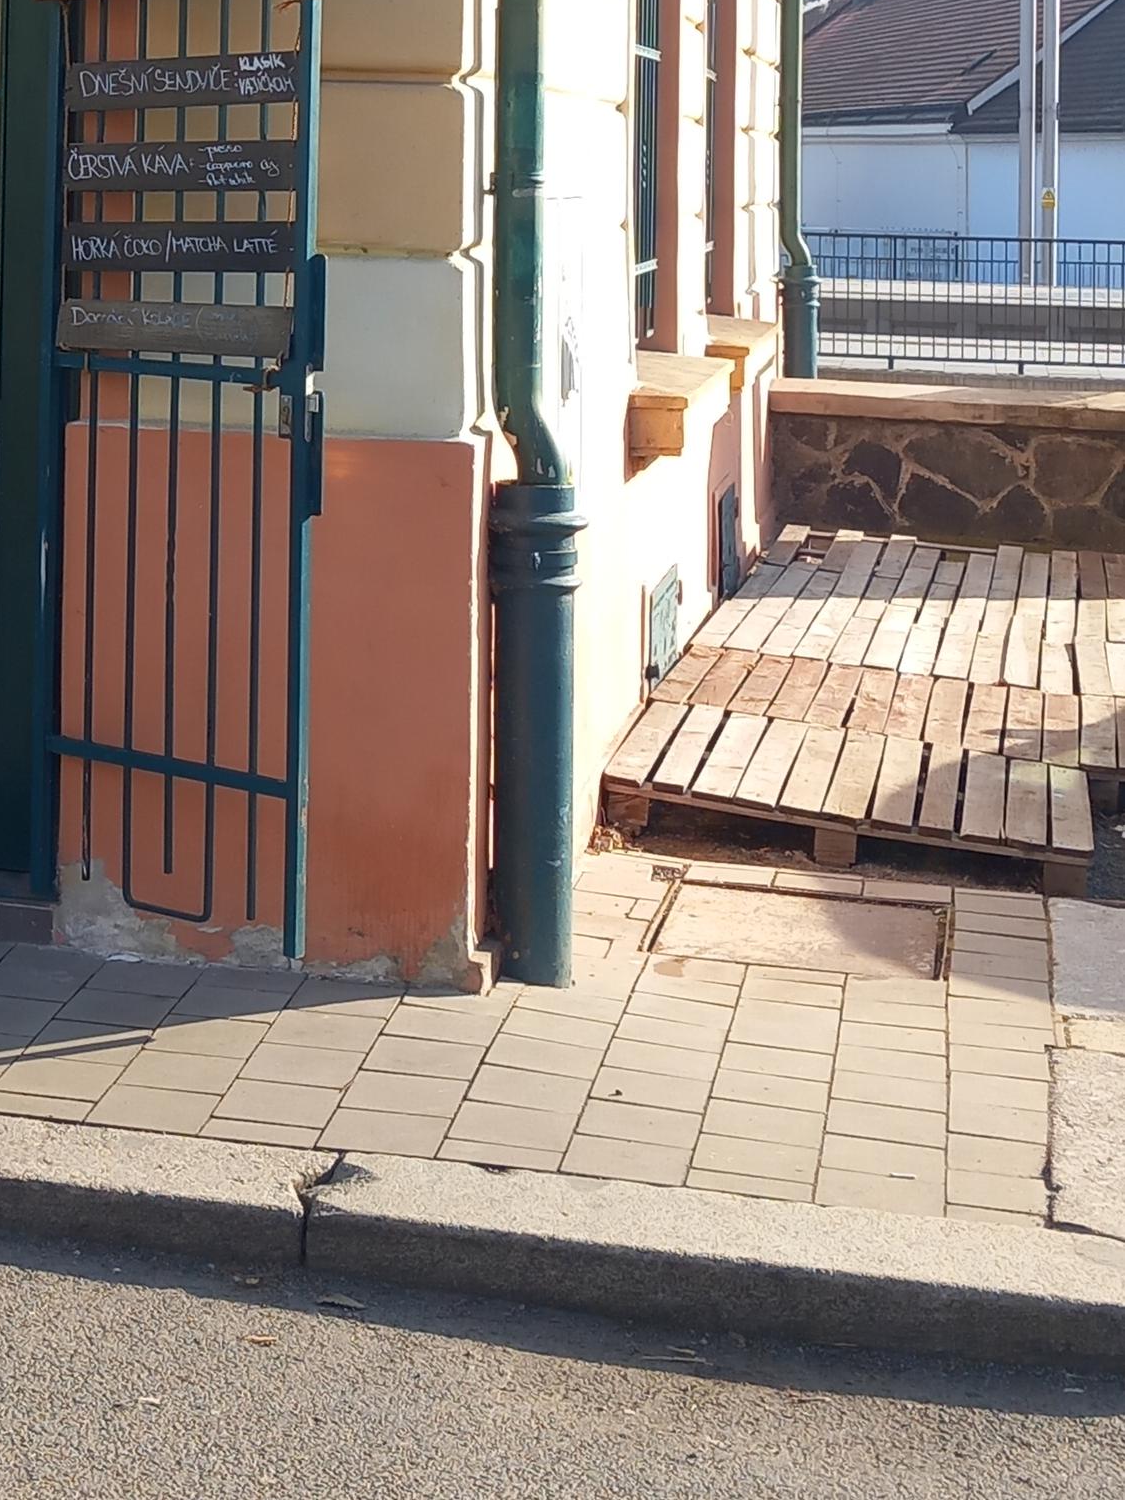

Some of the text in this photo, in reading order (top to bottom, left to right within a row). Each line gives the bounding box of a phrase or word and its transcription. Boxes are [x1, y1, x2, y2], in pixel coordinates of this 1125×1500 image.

[79, 66, 155, 98] DNEŠNÍ
[67, 147, 139, 181] ČERSTVÁ
[71, 230, 122, 261] HORKÁ
